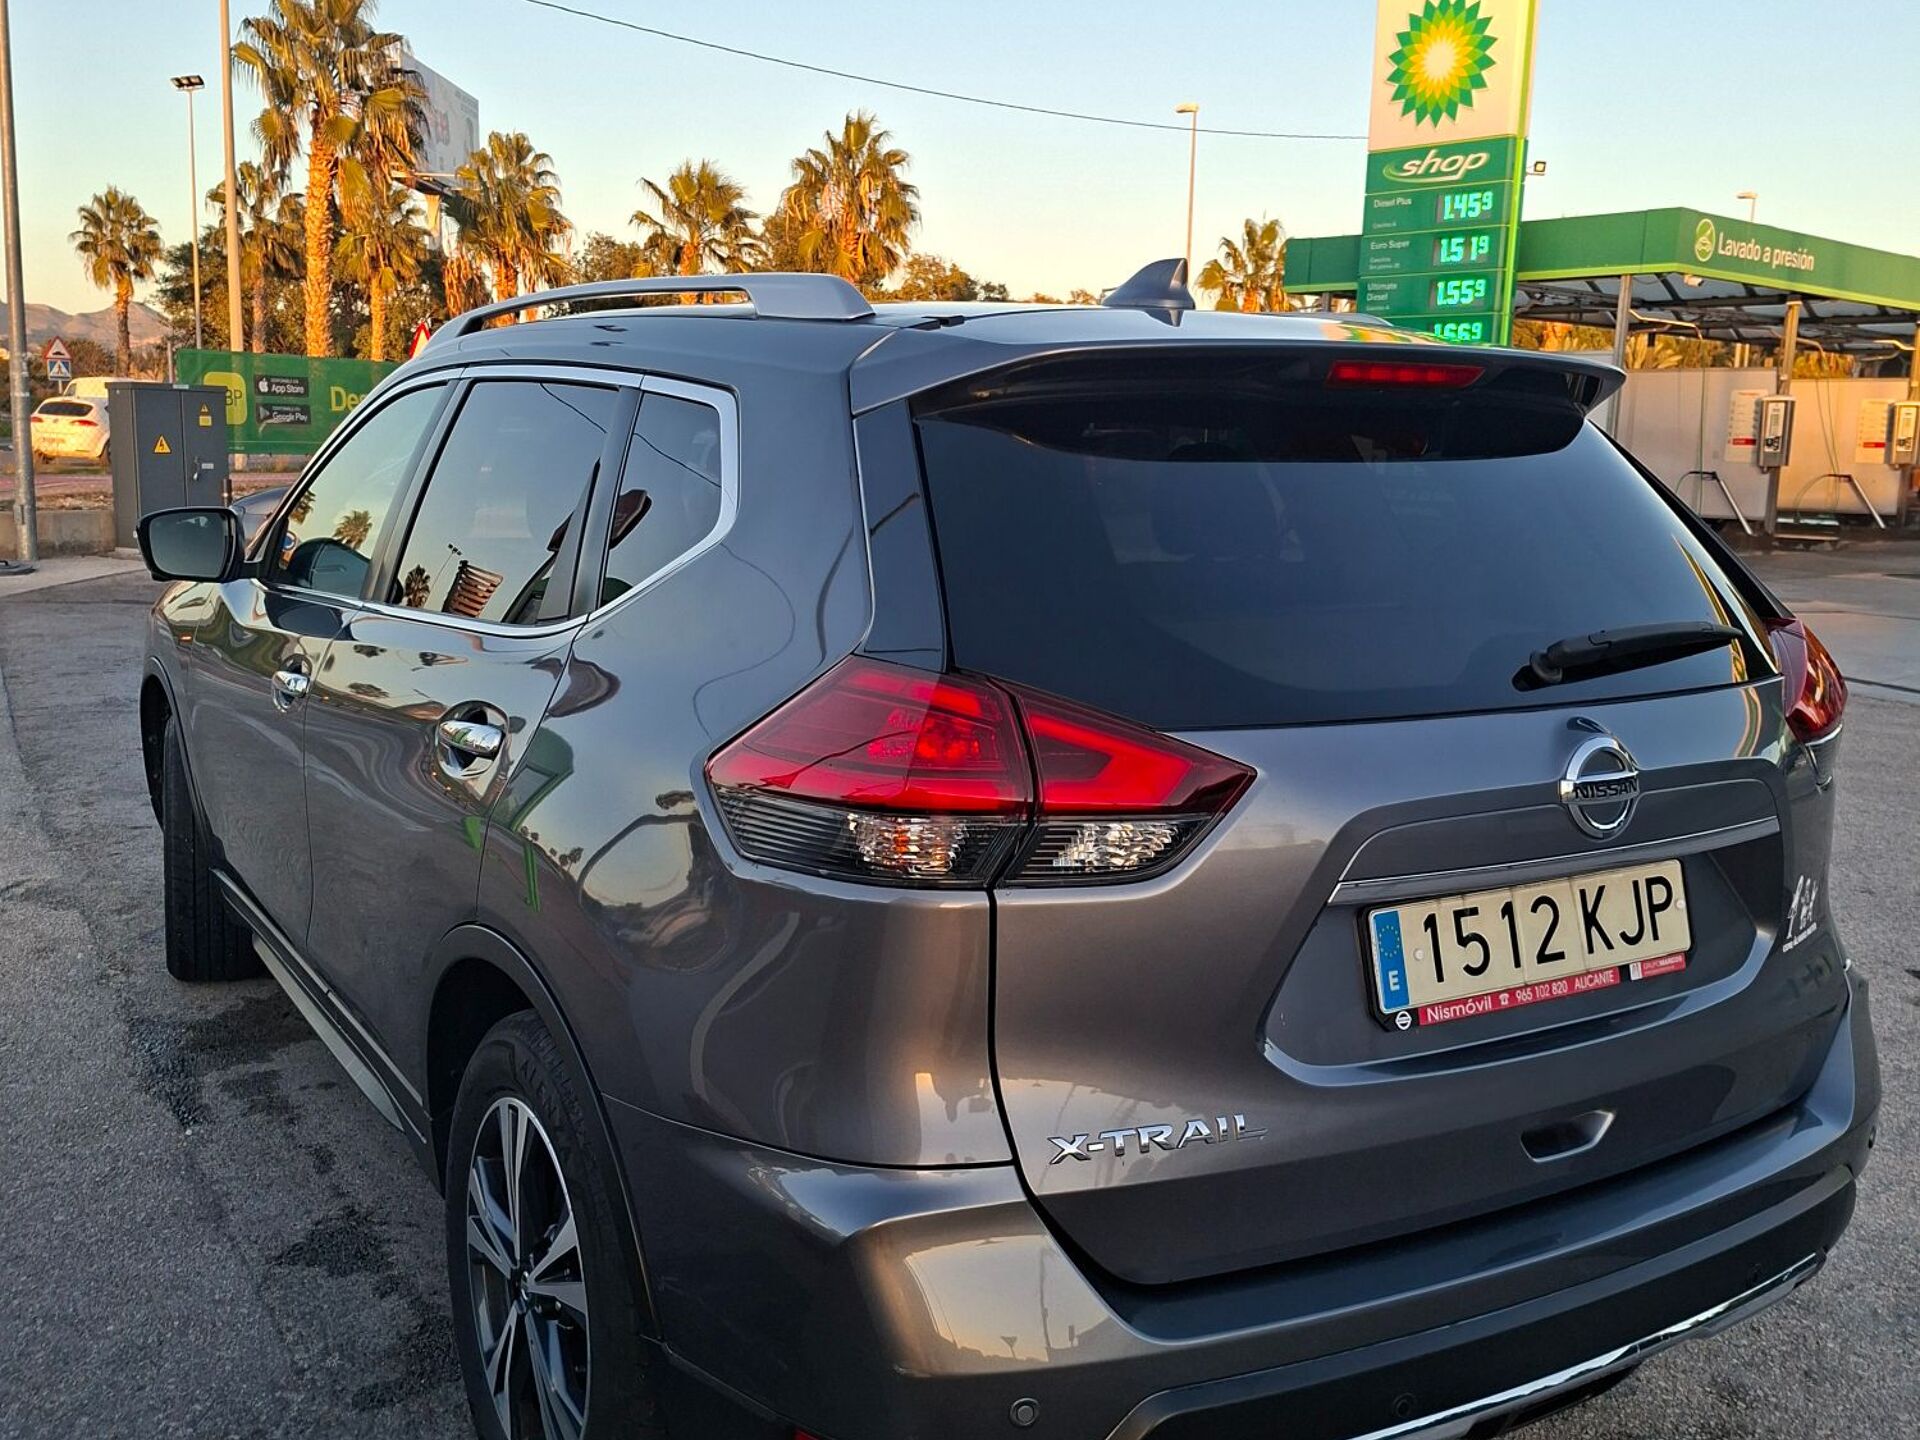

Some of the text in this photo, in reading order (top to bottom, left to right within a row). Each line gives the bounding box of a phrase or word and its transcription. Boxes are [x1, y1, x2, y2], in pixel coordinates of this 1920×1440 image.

[1402, 149, 1490, 180] shop
[1373, 197, 1412, 208] Diesel Plus
[1370, 240, 1410, 250] Euro Super
[1718, 232, 1814, 271] Lavado a presión
[1366, 292, 1389, 301] Diesel
[271, 384, 304, 394] App Store
[272, 411, 308, 423] Google Play
[1573, 779, 1637, 799] NISSAN
[1423, 875, 1674, 984] 1512 KJP
[1389, 970, 1399, 991] E
[1427, 994, 1492, 1022] Nismóvil
[1516, 987, 1533, 1003] 965
[1535, 985, 1550, 998] 102
[1552, 980, 1568, 994] 820
[1574, 970, 1614, 990] ALICANTE
[1048, 1113, 1268, 1165] X-TRAIL
